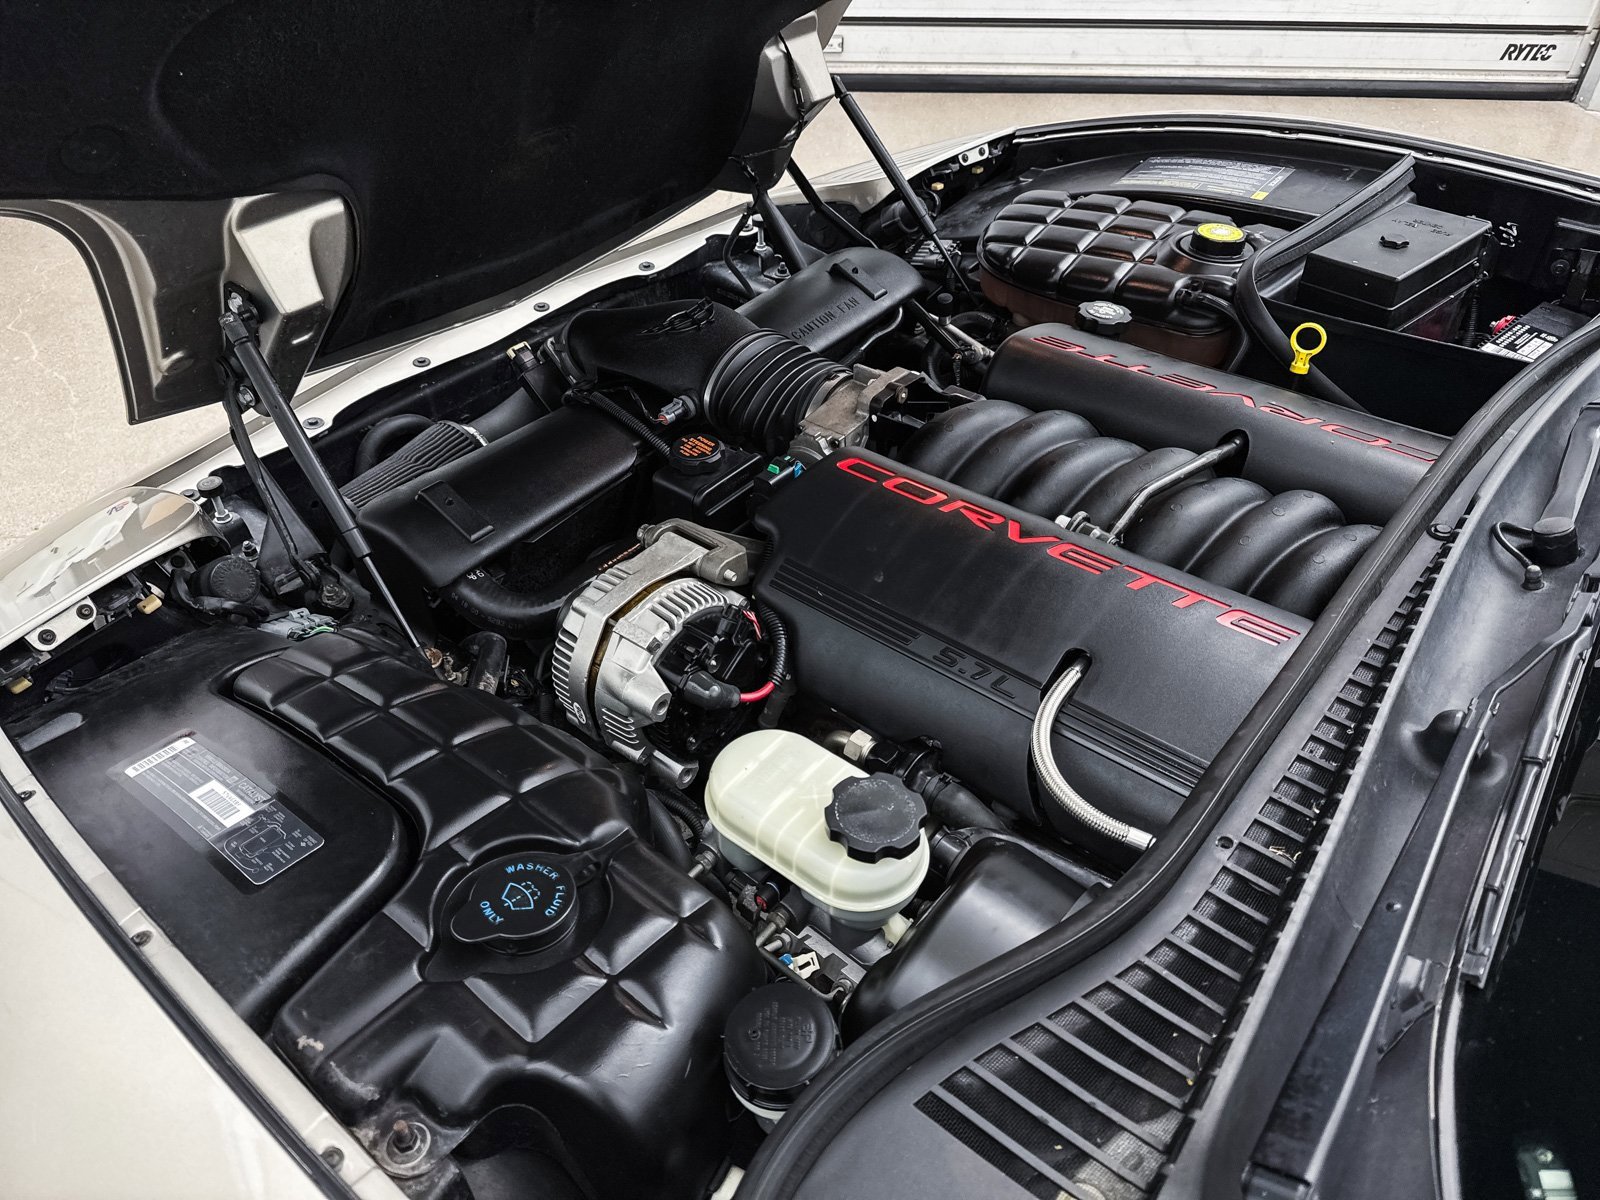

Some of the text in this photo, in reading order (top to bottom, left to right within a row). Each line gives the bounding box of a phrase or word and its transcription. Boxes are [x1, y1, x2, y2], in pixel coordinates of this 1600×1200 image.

[1499, 43, 1557, 61] RYTEC
[791, 296, 860, 340] CAUTION FAN
[1030, 335, 1440, 464] CORVETTE
[836, 457, 1301, 646] CORVETTE
[932, 646, 1016, 699] 5.7L
[480, 900, 505, 925] ONLY
[505, 862, 566, 916] WASHER FLUID
